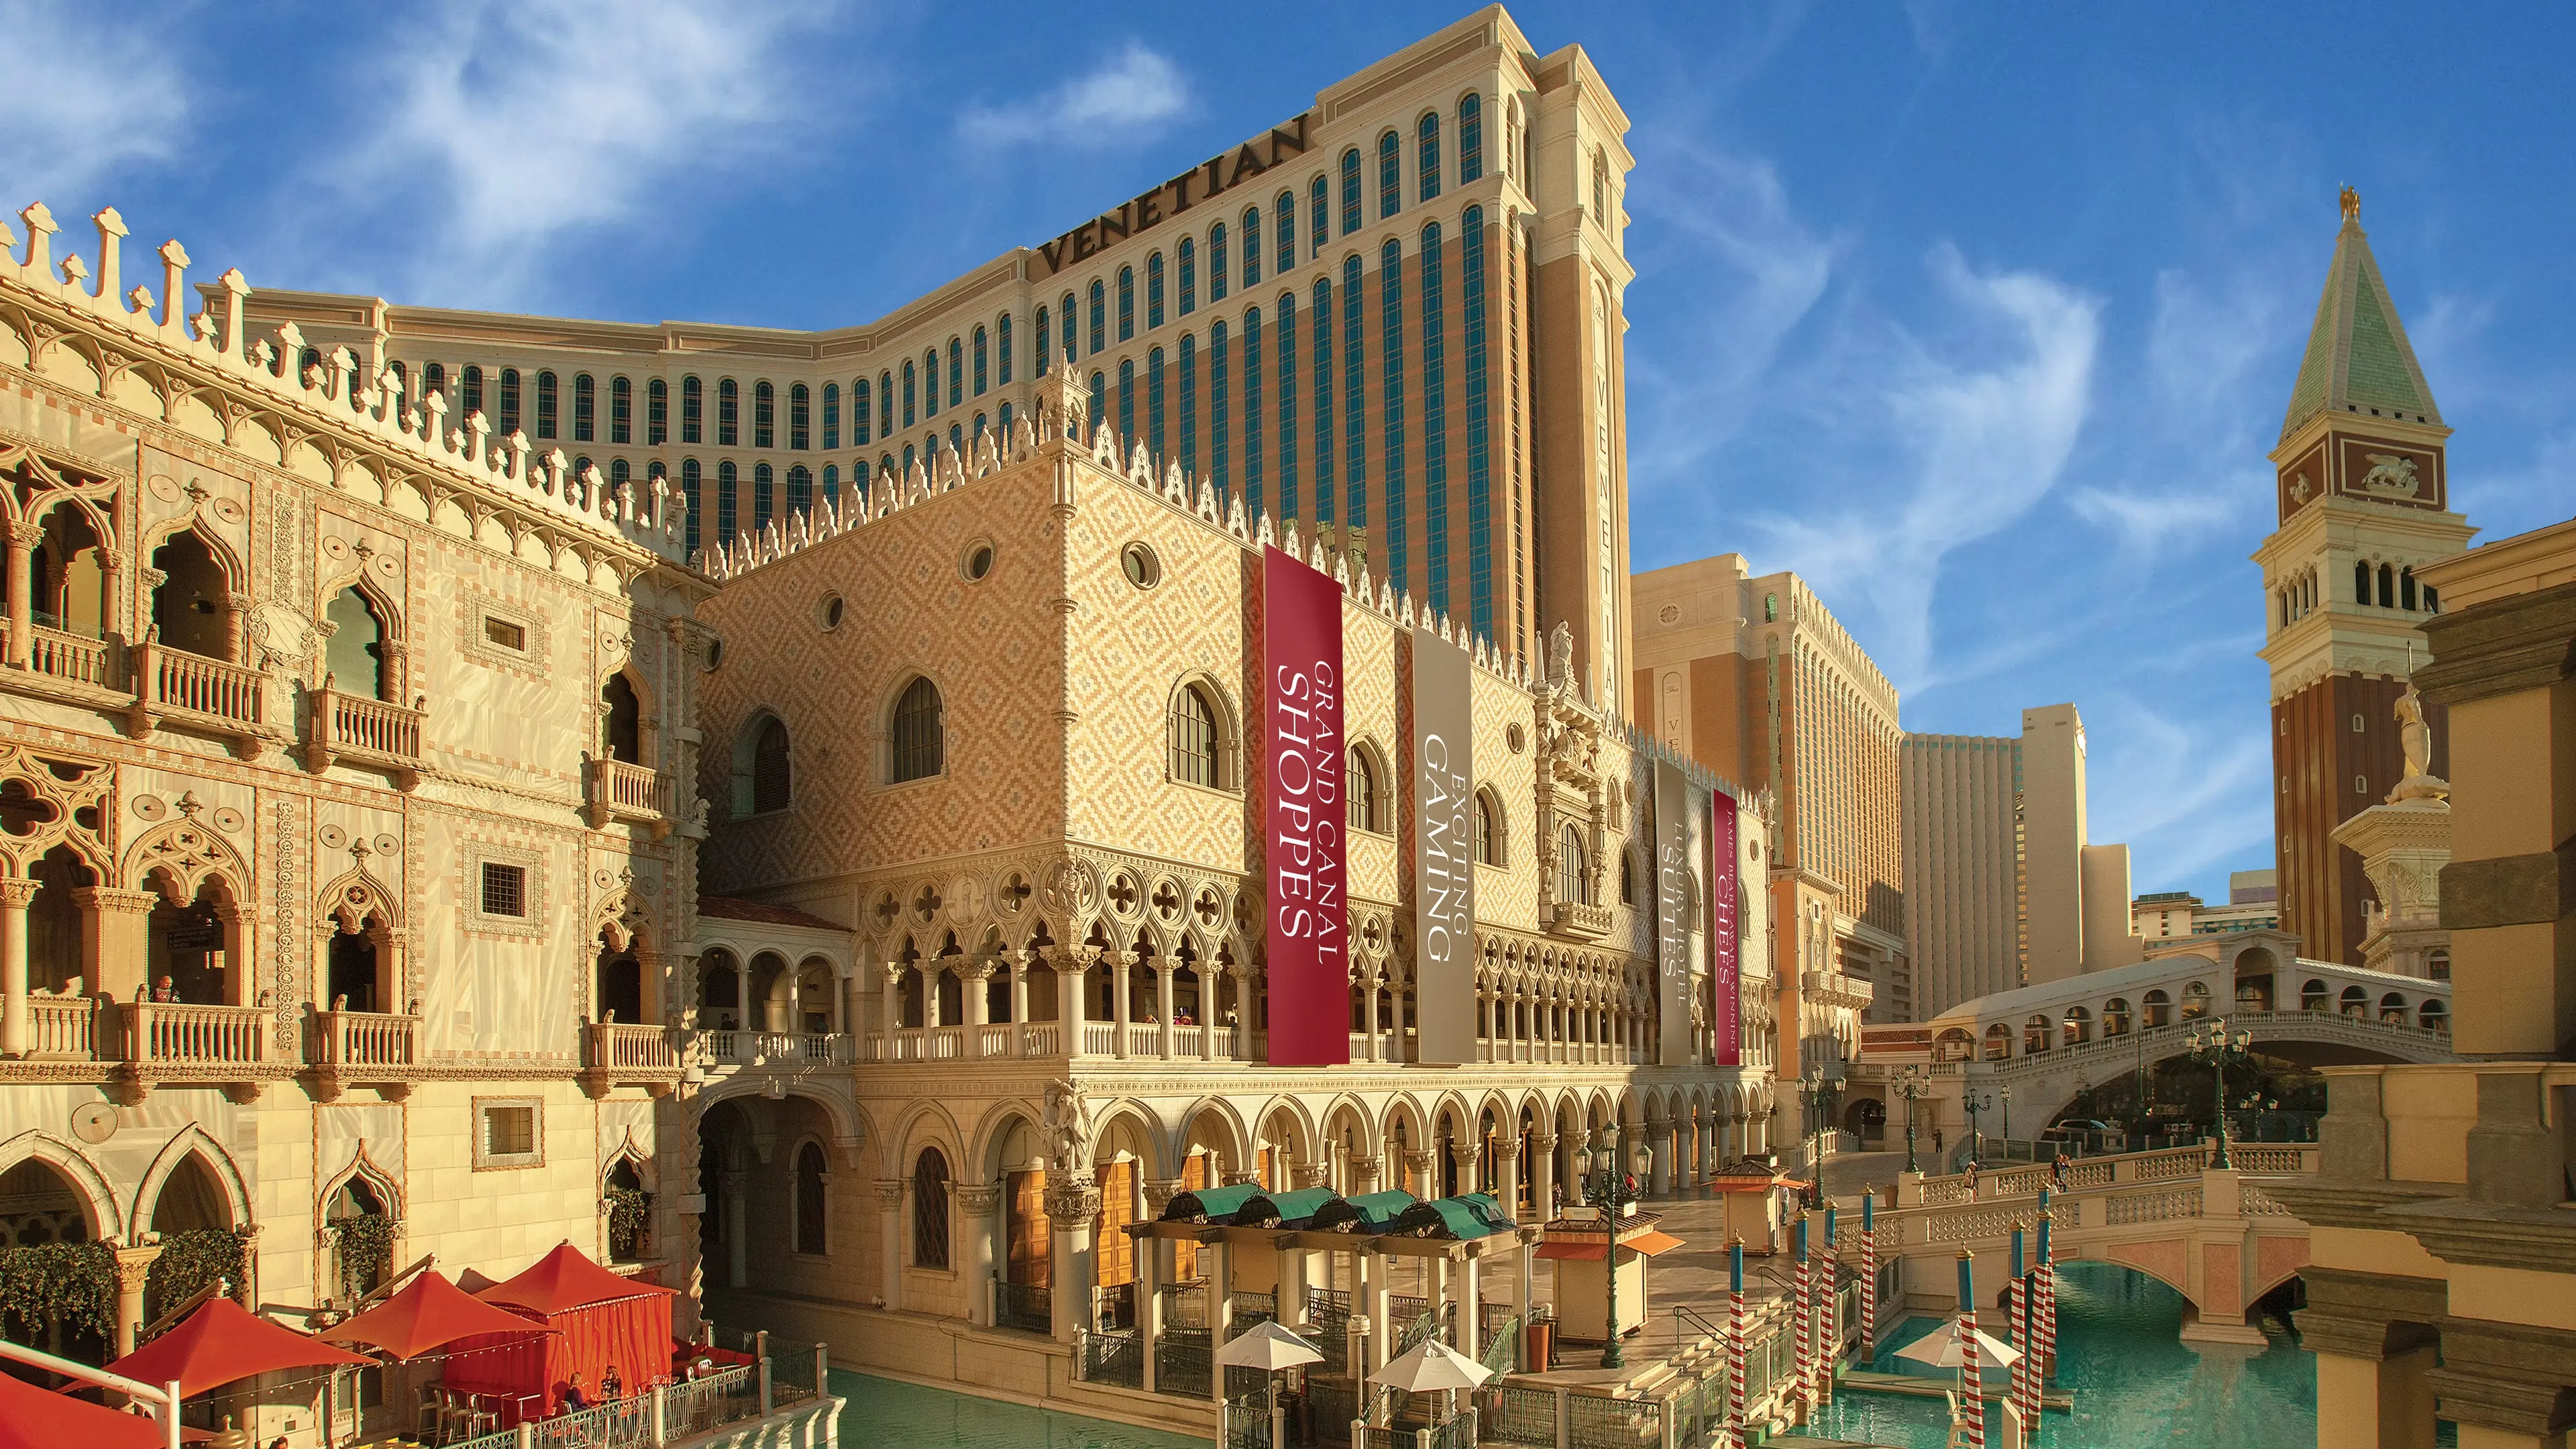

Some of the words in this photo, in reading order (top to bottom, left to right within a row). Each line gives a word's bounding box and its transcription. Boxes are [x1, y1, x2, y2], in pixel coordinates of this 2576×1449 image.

[1038, 113, 1309, 274] VENETIAN
[1593, 303, 1604, 323] The
[1597, 373, 1613, 694] VENETIA
[1314, 659, 1336, 805] GRAND
[1666, 685, 1679, 694] The
[1277, 665, 1312, 938] SHOPPES
[1424, 734, 1450, 963] GAMING
[1452, 771, 1468, 936] EXCITING
[1674, 821, 1684, 918] LUXURY
[1317, 820, 1338, 965] CANAL
[1662, 843, 1676, 977] SUITES
[1718, 874, 1729, 984] CHEFS
[1677, 926, 1686, 1008] HOTEL
